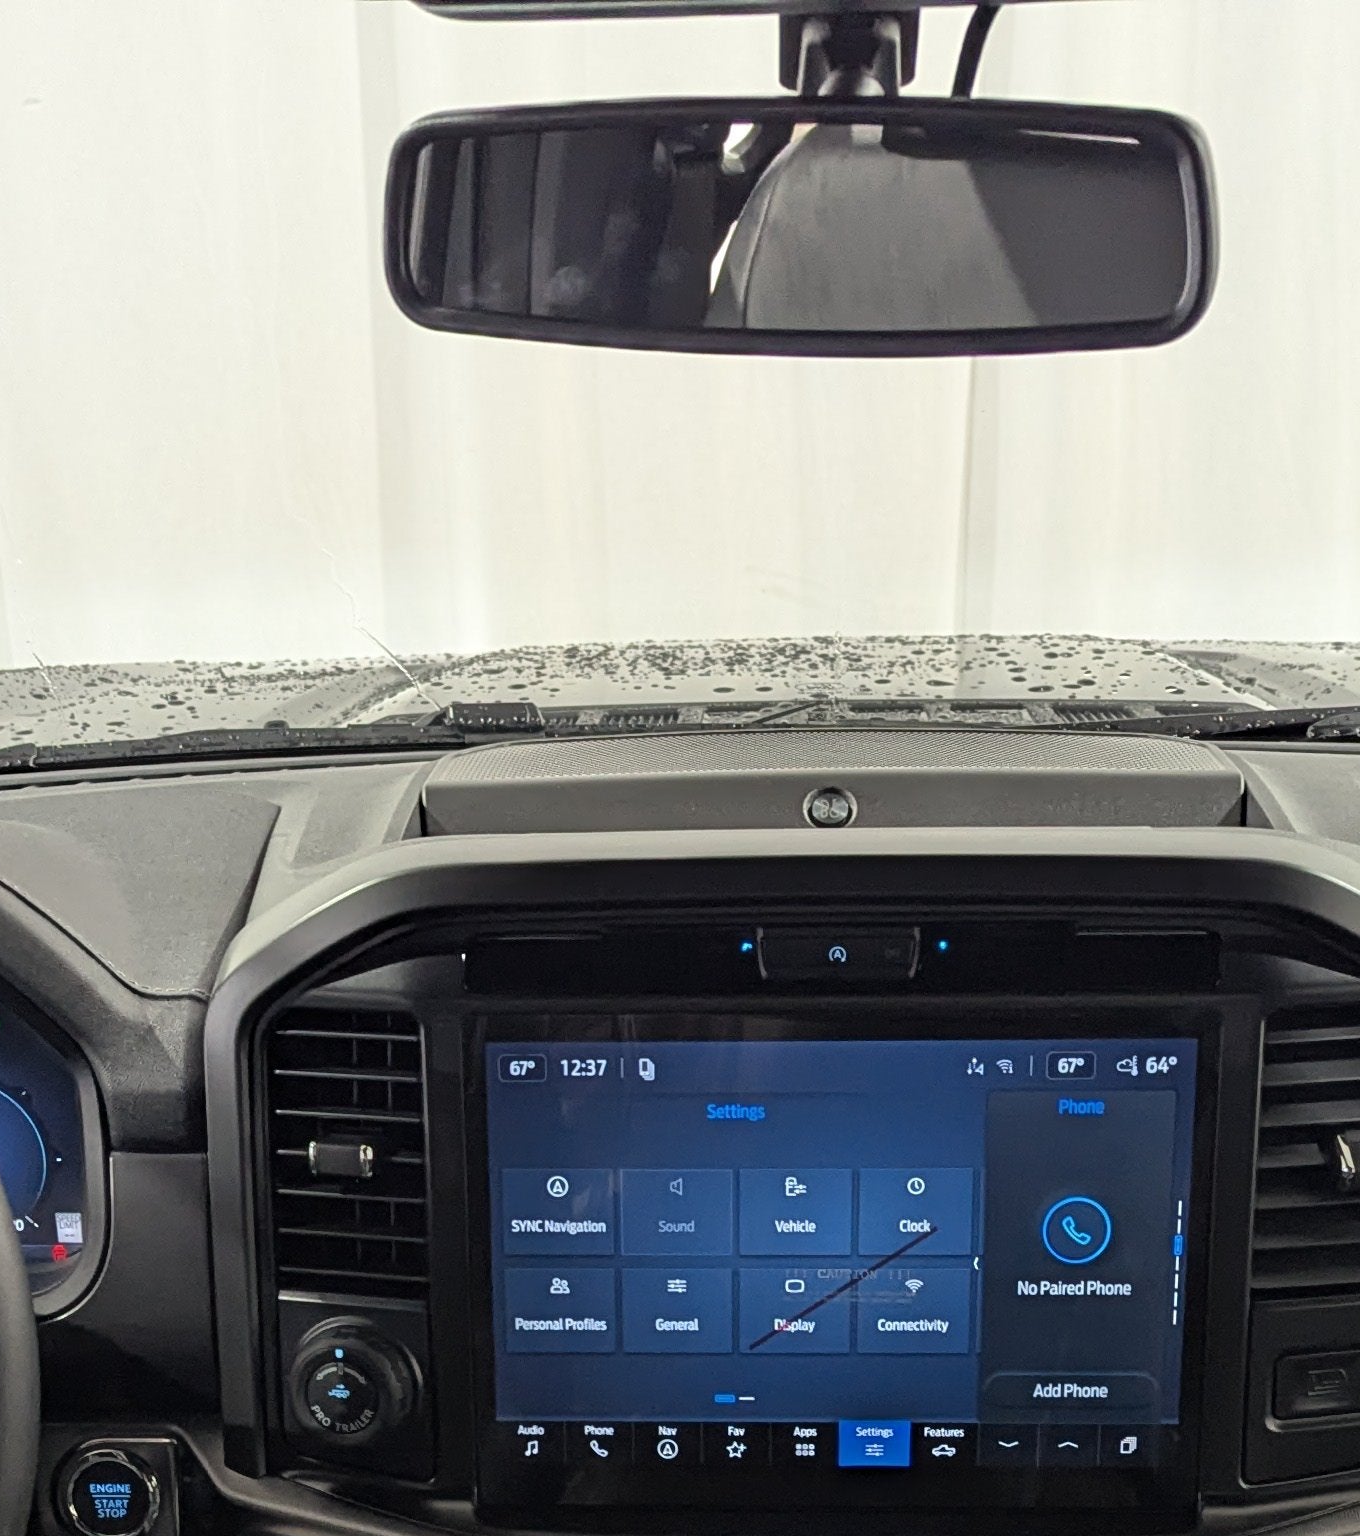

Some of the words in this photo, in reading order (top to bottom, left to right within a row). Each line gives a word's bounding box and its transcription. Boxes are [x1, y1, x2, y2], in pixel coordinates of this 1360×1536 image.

[560, 1059, 607, 1077] 12:37
[706, 1104, 766, 1121] Settings
[1058, 1098, 1105, 1115] Phone
[511, 1220, 544, 1233] SYNC
[544, 1219, 607, 1235] Navigation
[658, 1219, 696, 1234] Sound
[774, 1220, 817, 1233] Vehicle
[899, 1219, 932, 1233] Clock
[1017, 1281, 1038, 1296] No
[1040, 1280, 1085, 1296] Paired
[1086, 1280, 1132, 1296] Phone
[515, 1318, 564, 1331] Personal
[565, 1318, 607, 1331] Profiles
[655, 1318, 699, 1332] General
[774, 1319, 816, 1333] Display
[877, 1318, 949, 1334] Connectivity
[1033, 1383, 1062, 1398] Add
[1064, 1383, 1109, 1398] Phone
[310, 1404, 331, 1427] PRO
[335, 1408, 375, 1433] TRAILER
[518, 1425, 544, 1436] Audio
[584, 1425, 614, 1436] Phone
[658, 1426, 677, 1436] Nav
[728, 1426, 745, 1436] Fav
[793, 1426, 817, 1438] Apps
[856, 1426, 894, 1438] Settings
[924, 1426, 965, 1438] Features
[90, 1483, 131, 1493] ENGINE
[94, 1499, 129, 1508] START
[97, 1508, 127, 1518] STOP
